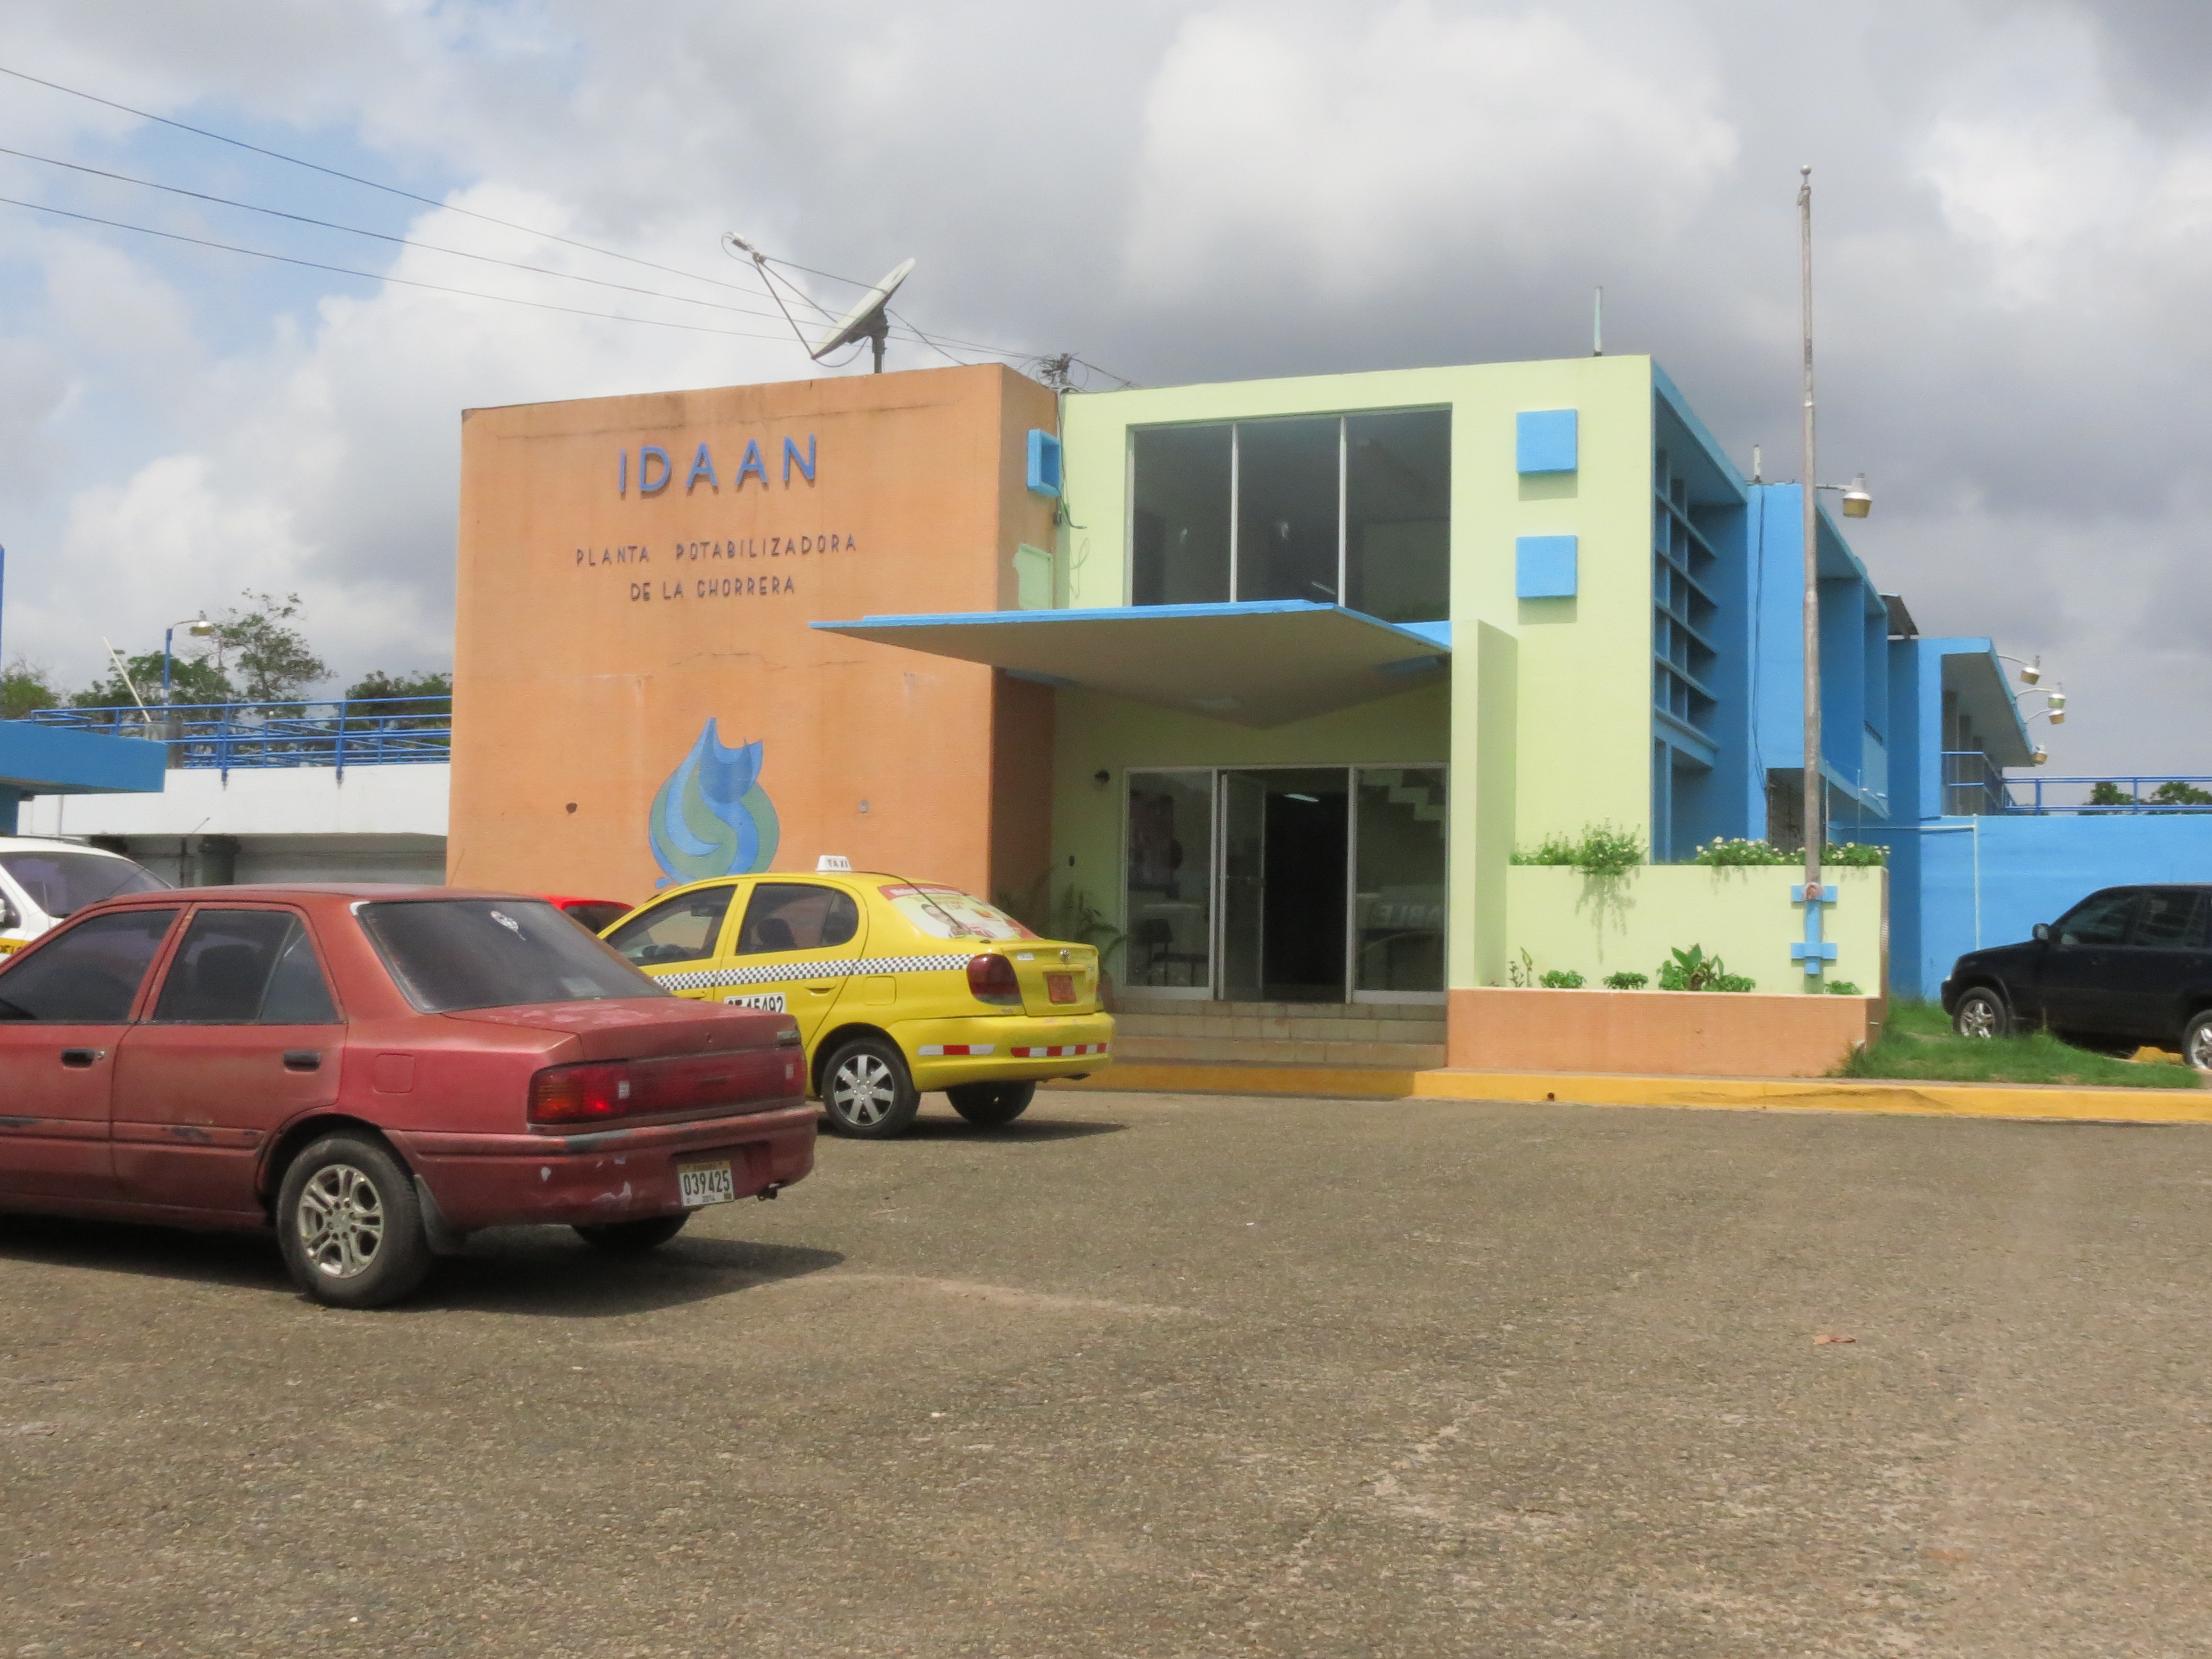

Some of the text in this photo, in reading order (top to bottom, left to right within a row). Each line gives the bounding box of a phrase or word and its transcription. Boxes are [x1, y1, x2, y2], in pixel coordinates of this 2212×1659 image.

[618, 434, 816, 494] IDAAN
[576, 533, 857, 566] PLANTA POTABILIZADORA
[630, 576, 795, 602] DE LA CHORRERA
[827, 859, 848, 868] TAXI
[683, 1169, 730, 1196] 039425
